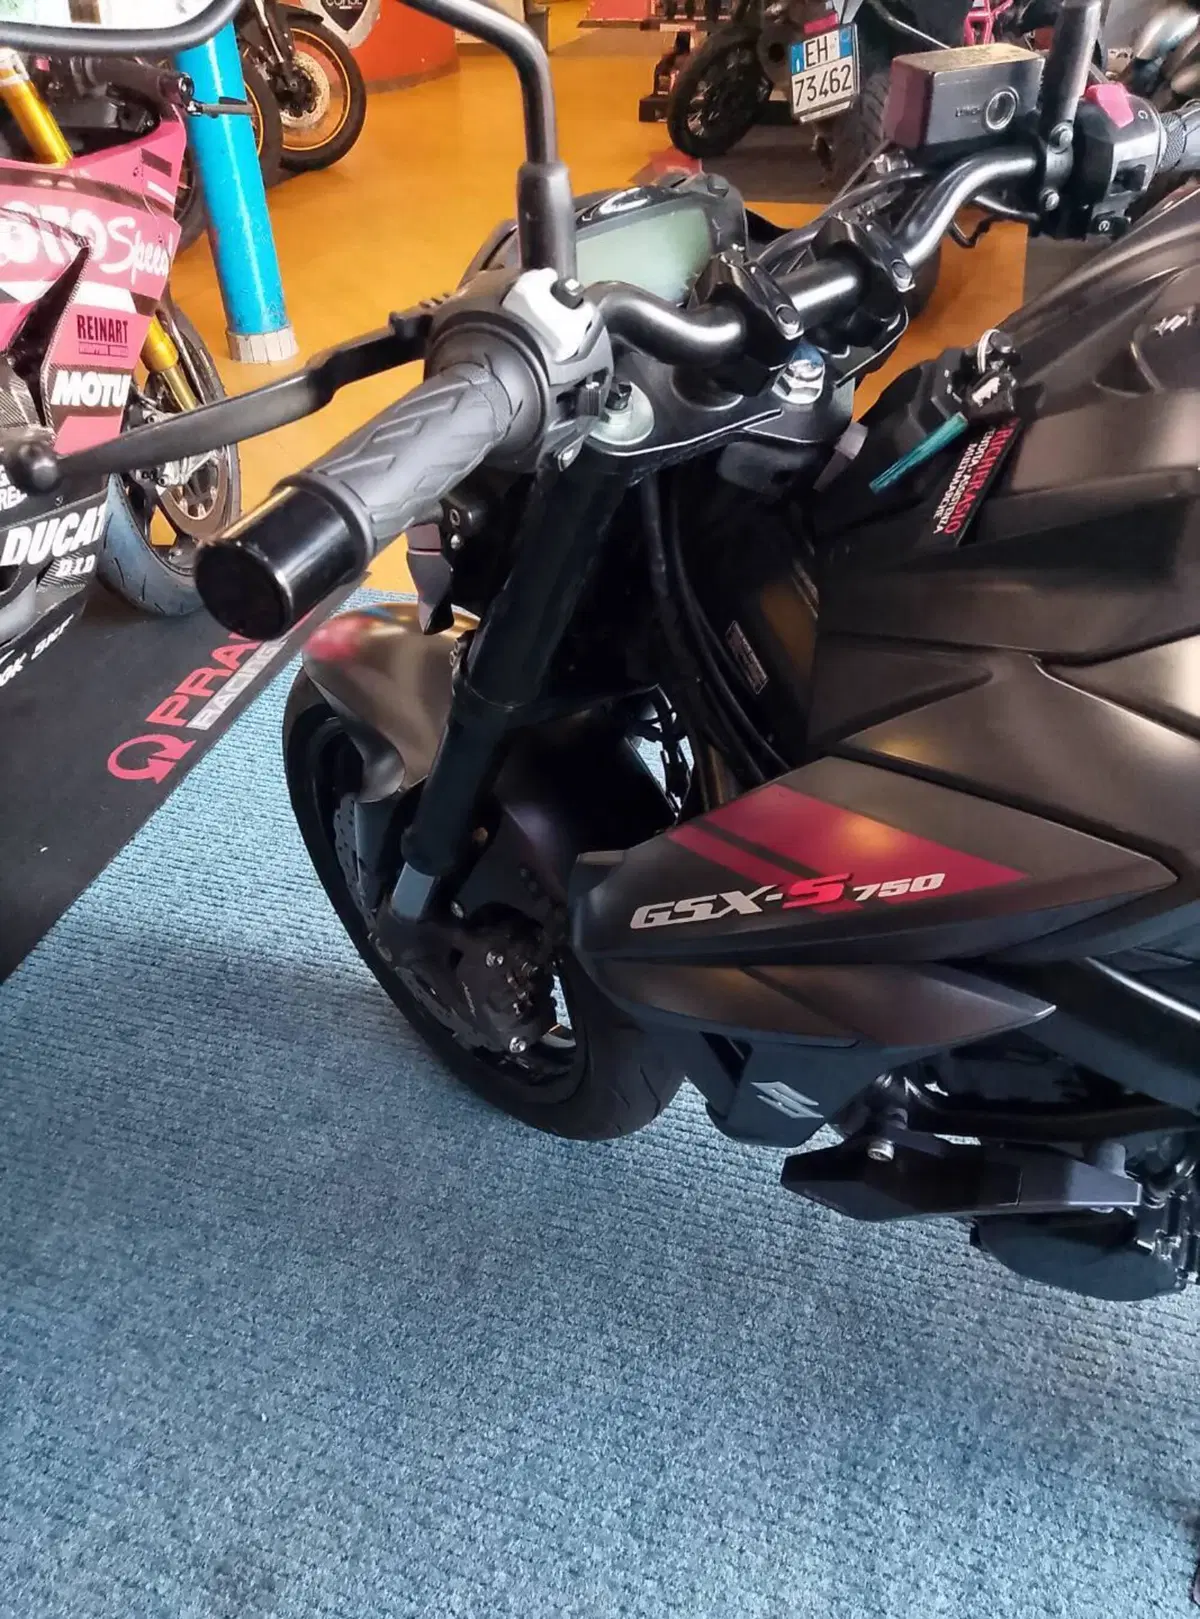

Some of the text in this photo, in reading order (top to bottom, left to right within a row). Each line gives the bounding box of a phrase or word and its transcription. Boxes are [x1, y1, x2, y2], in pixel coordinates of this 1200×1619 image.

[805, 35, 829, 67] EH
[795, 64, 852, 107] 73462
[77, 314, 128, 344] REINART
[933, 426, 996, 534] ENDITA ASSISTENZA
[189, 640, 284, 729] RACING
